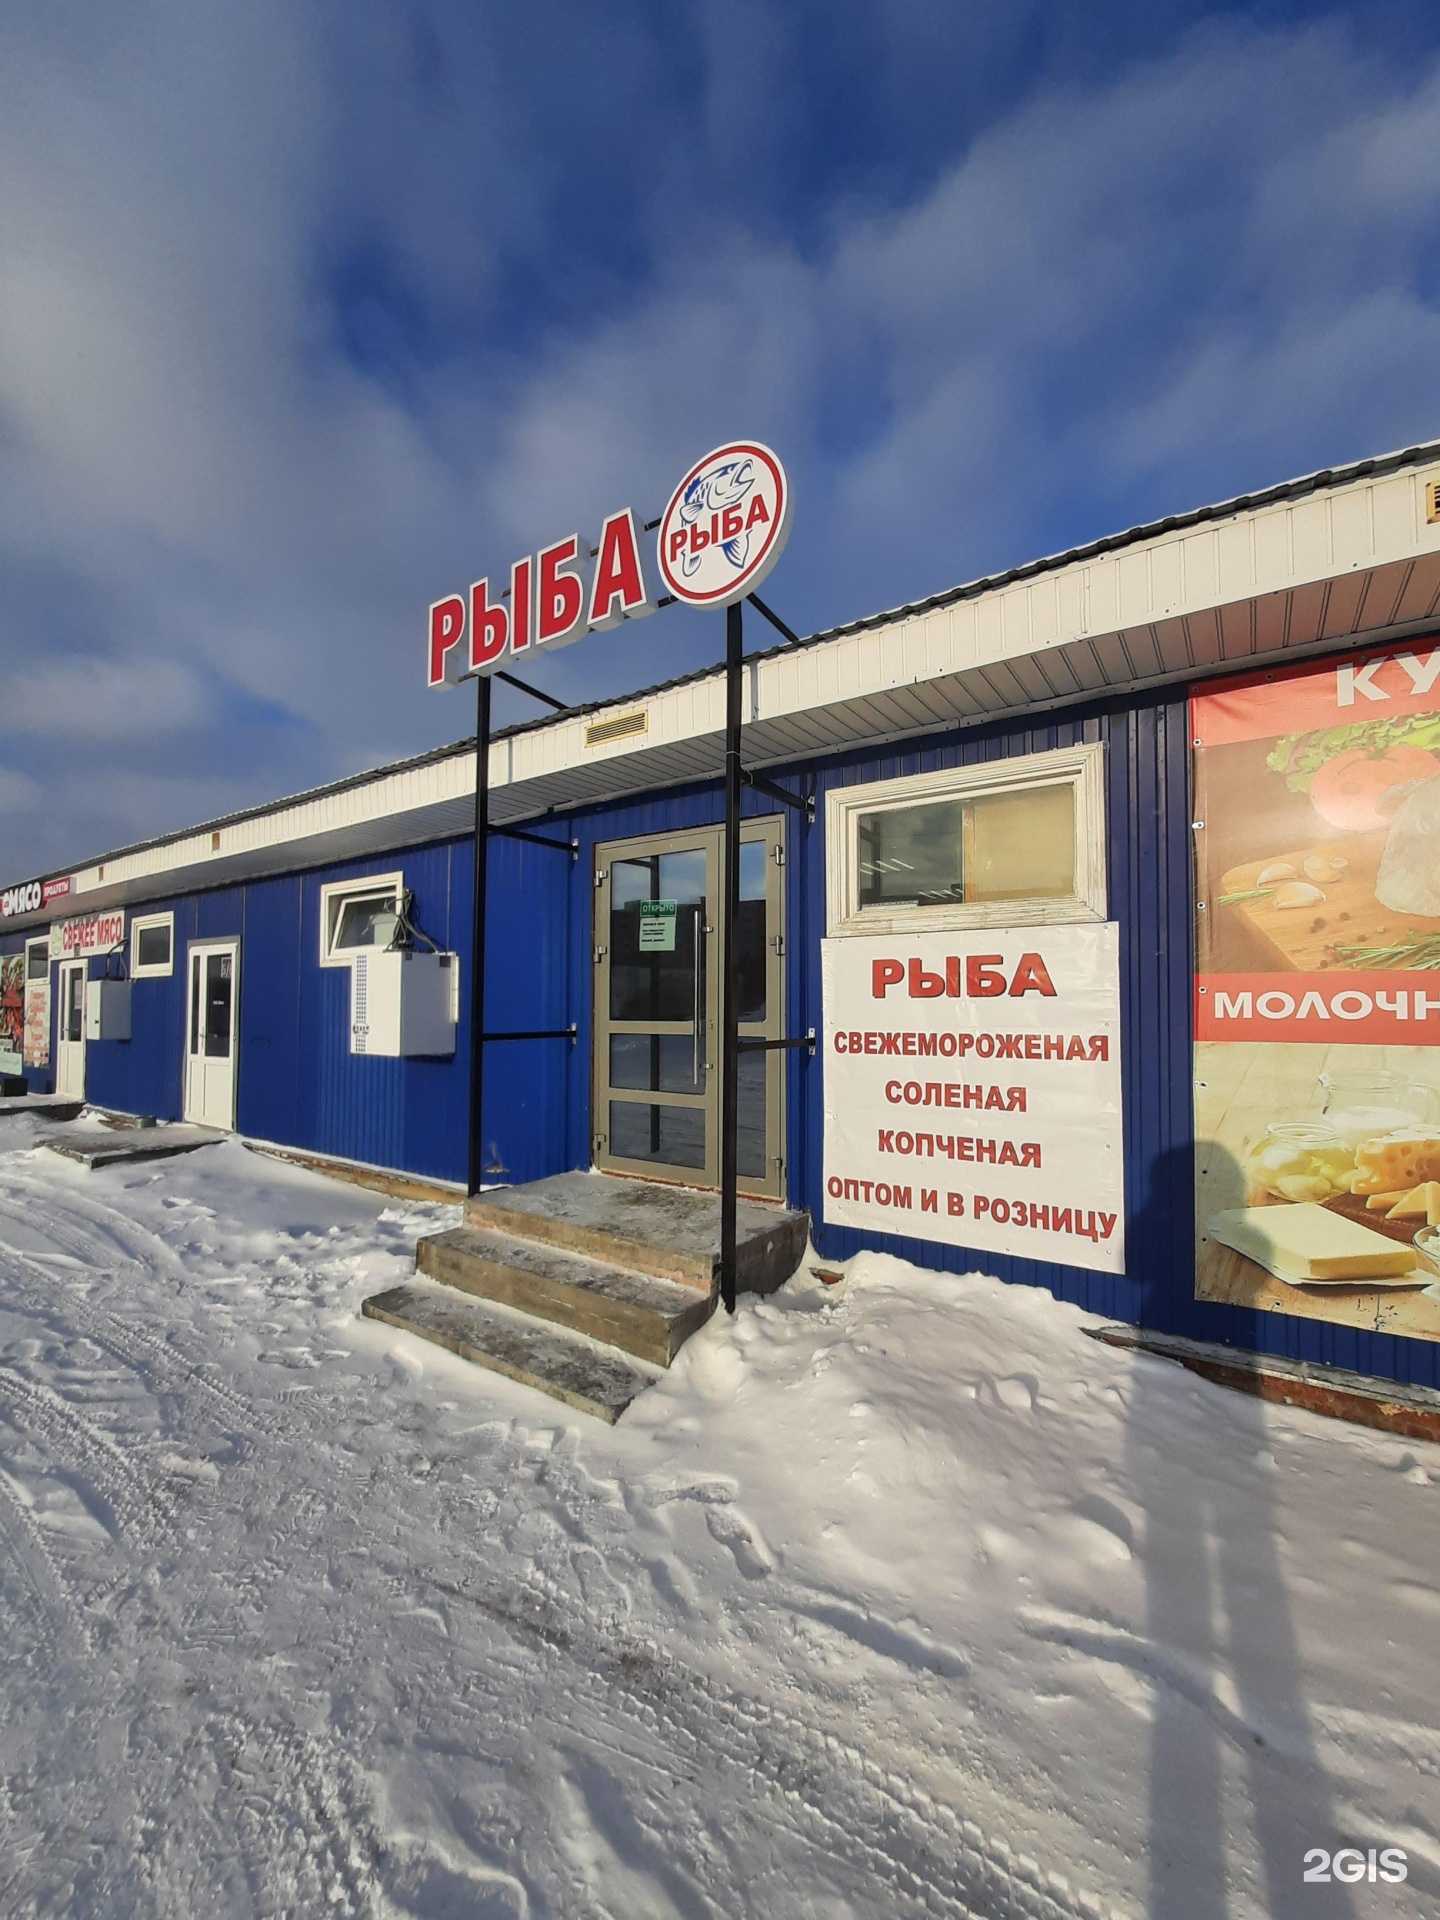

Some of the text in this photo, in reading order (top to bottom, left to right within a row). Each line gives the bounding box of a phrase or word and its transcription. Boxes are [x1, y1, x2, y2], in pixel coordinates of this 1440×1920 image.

[669, 494, 770, 562] РЫБА
[428, 507, 648, 688] РЫБА
[97, 916, 122, 945] МЯСО
[872, 953, 1057, 999] РЫБА
[833, 1031, 1109, 1062] СВЕЖЕМОРОЖЕНАЯ
[885, 1080, 1027, 1112] СОЛЕНАЯ
[878, 1129, 1041, 1168] КОПЧЕНАЯ
[827, 1176, 1118, 1243] ОПТОМ И В РОЗНИЦУ
